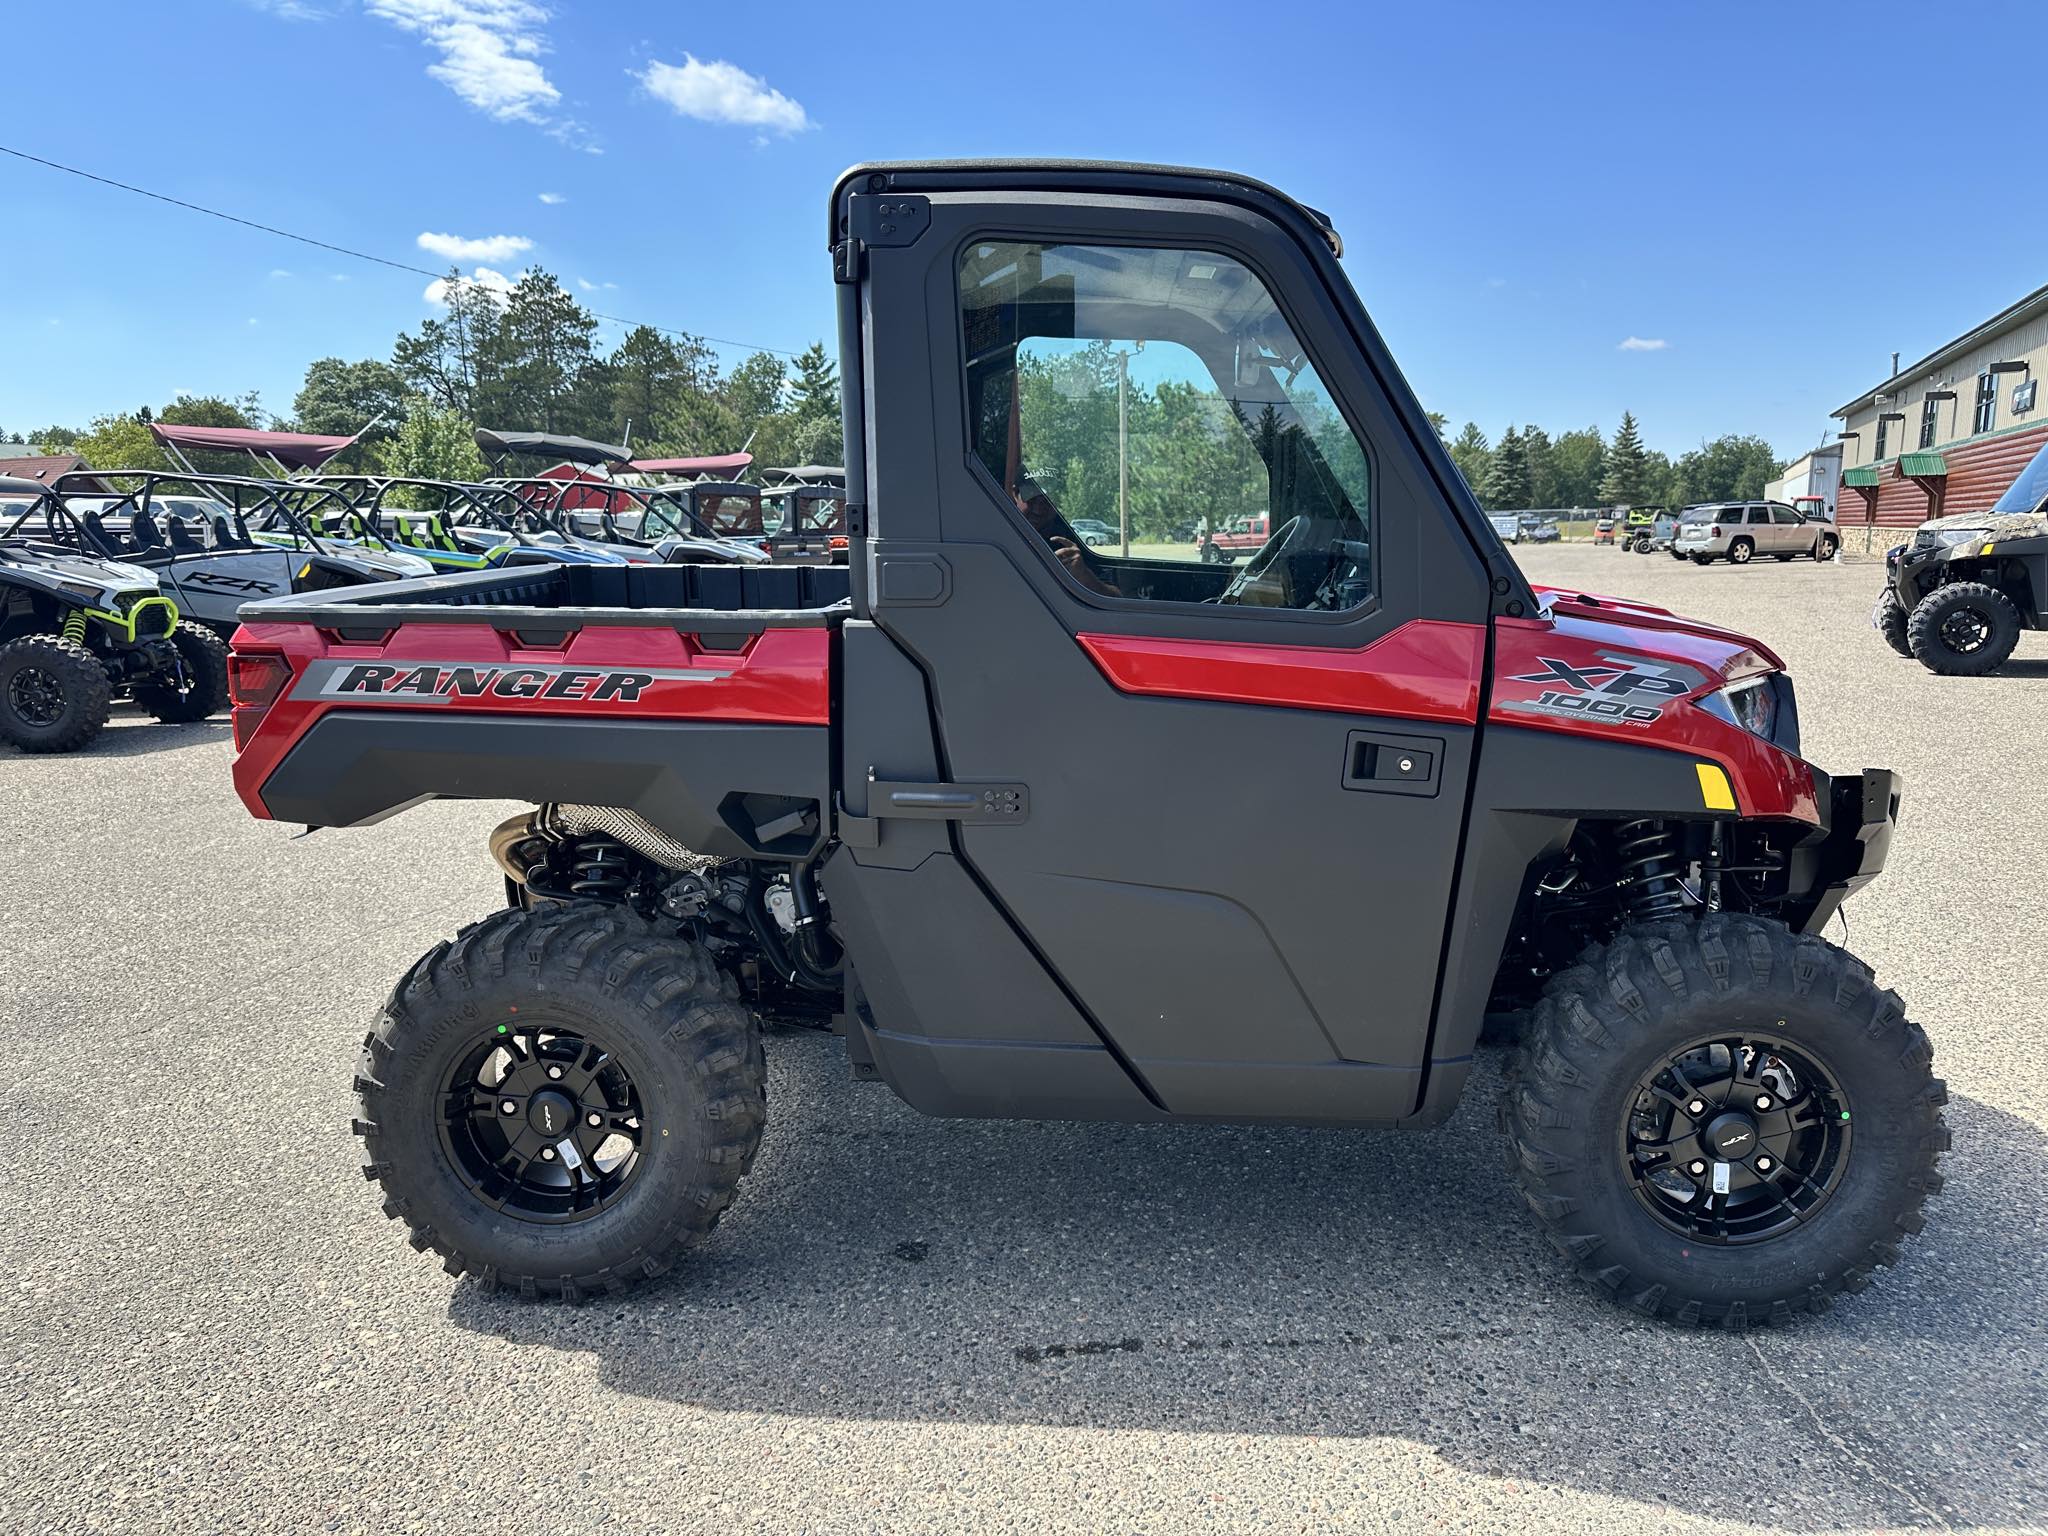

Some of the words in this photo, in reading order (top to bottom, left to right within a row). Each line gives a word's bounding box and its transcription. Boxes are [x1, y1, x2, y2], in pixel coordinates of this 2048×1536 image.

[182, 571, 279, 594] RZR
[337, 664, 655, 702] RANGER
[1504, 656, 1691, 698] XP
[1534, 706, 1562, 715] DUAL
[1566, 711, 1624, 724] OVERHEAD
[1625, 721, 1651, 729] CAM
[1538, 690, 1663, 723] 1000
